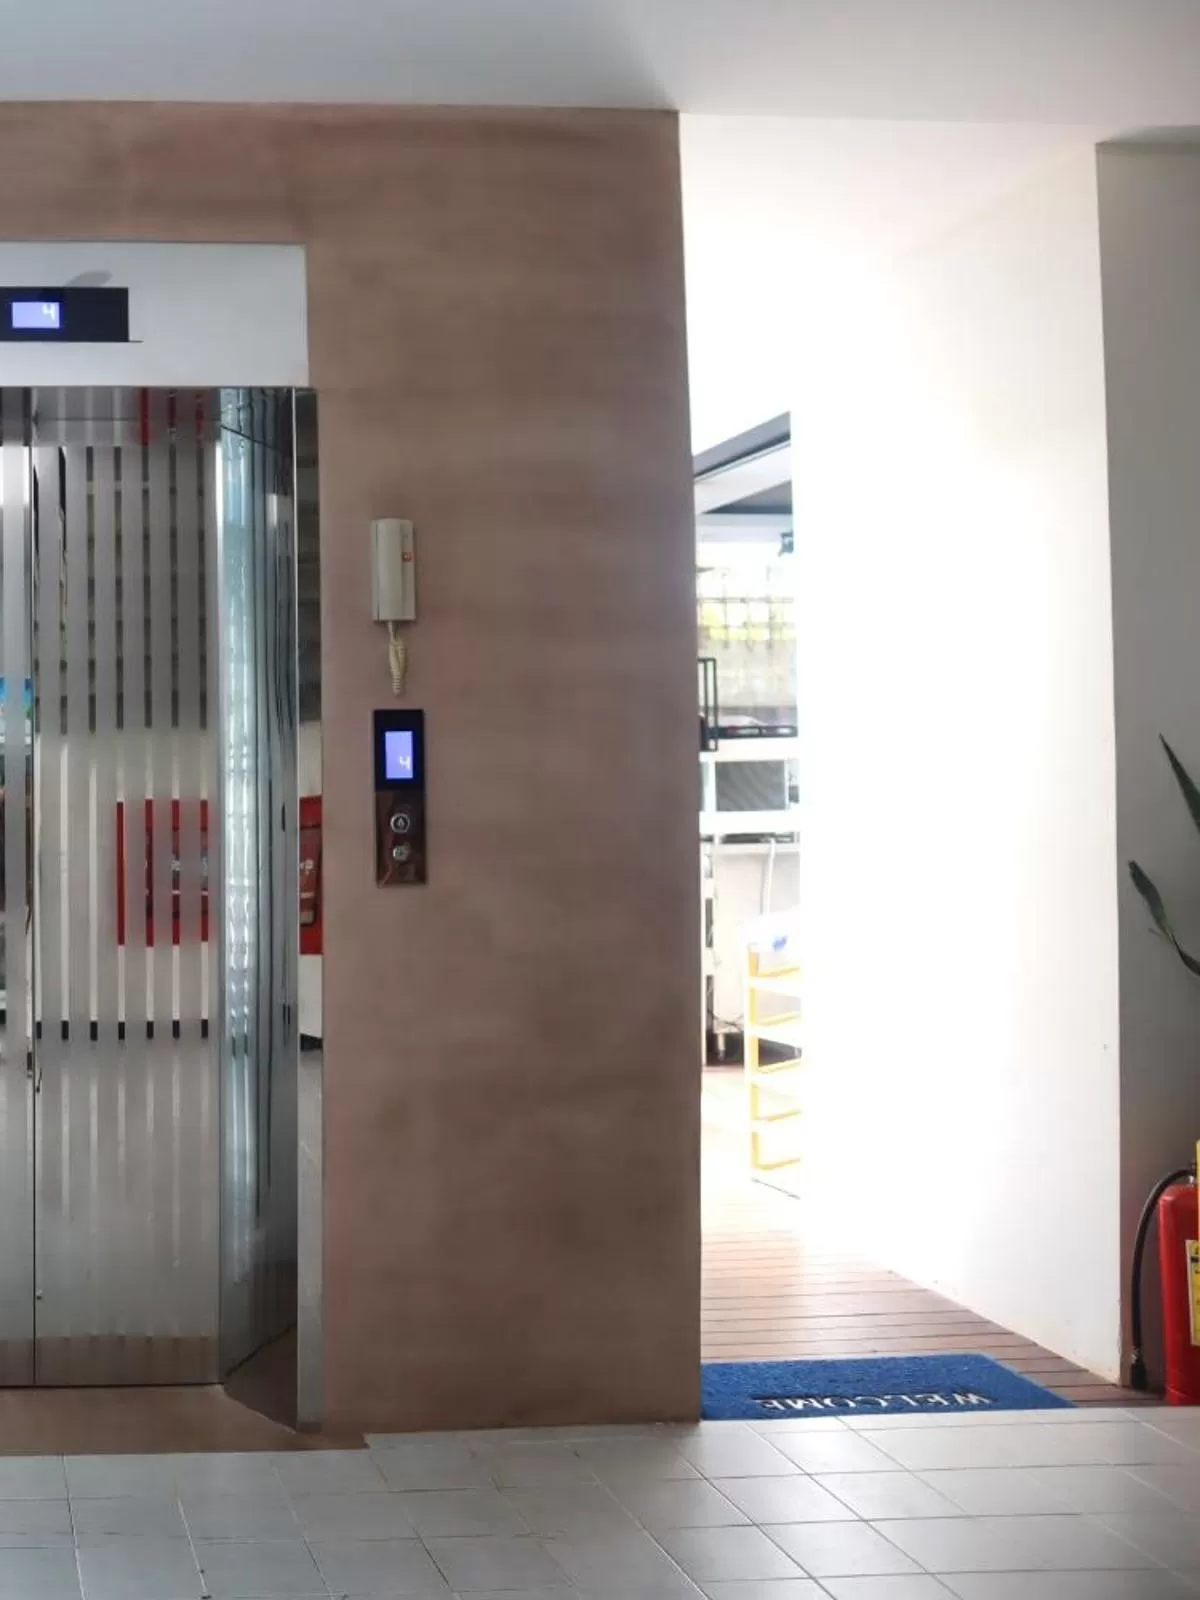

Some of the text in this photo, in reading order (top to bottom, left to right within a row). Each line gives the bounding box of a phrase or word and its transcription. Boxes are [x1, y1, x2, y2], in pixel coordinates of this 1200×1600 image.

[41, 303, 56, 320] 4
[399, 755, 411, 770] 4
[753, 1392, 992, 1410] WELCOME
